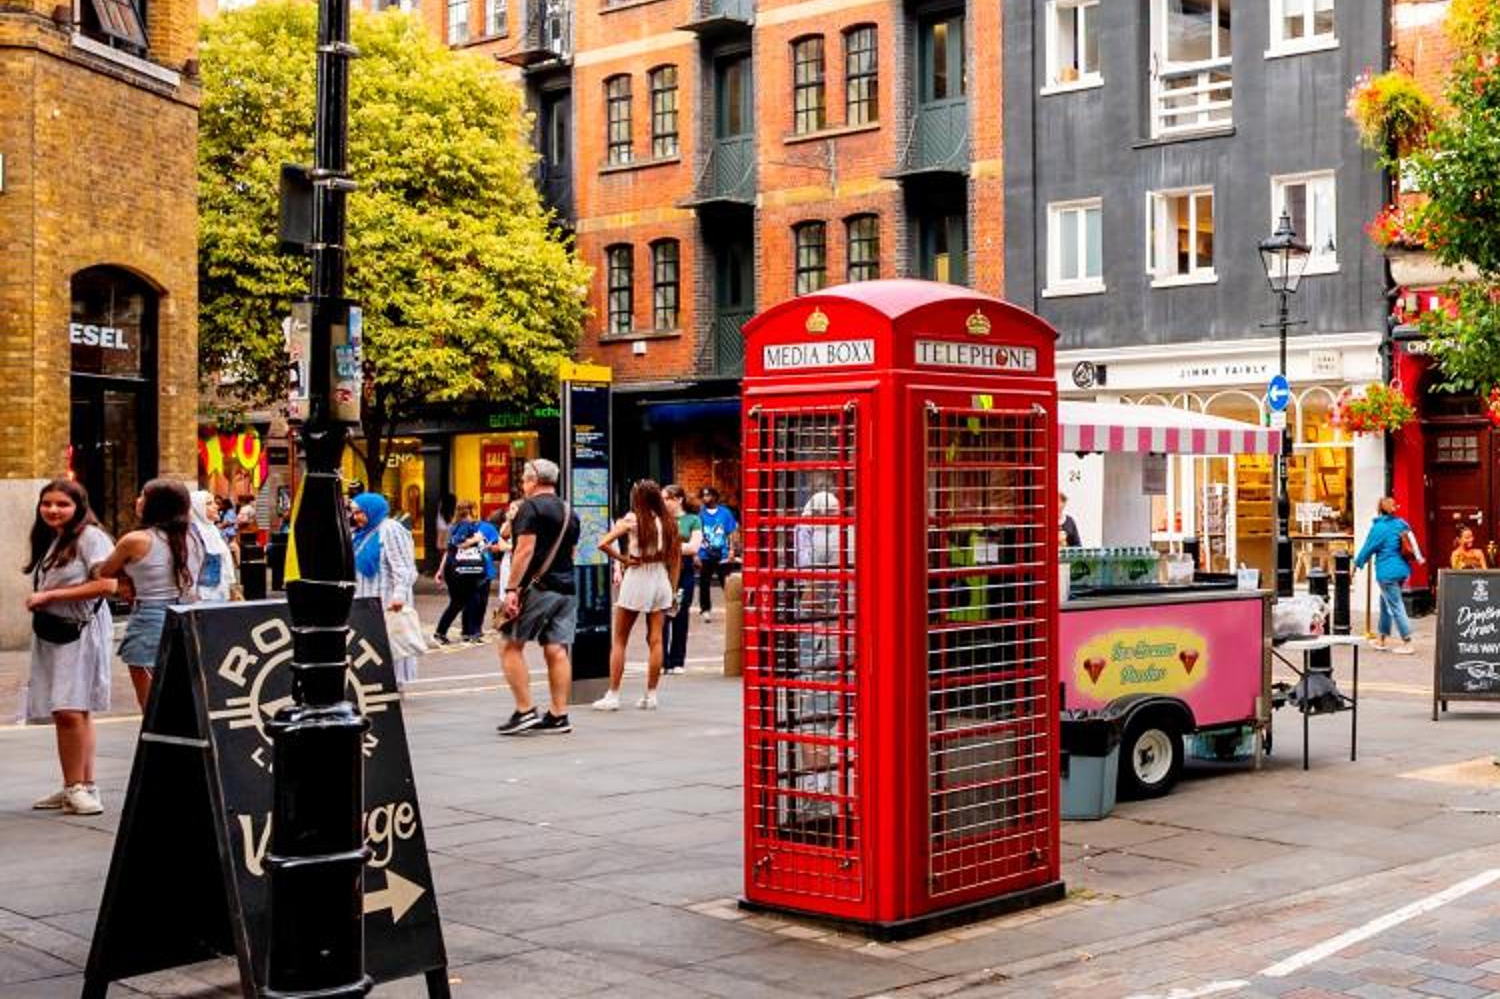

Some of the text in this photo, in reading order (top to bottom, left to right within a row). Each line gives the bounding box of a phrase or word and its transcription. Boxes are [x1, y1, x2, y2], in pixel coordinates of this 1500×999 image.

[767, 341, 873, 367] MEDIA BOXX
[919, 341, 1034, 369] TELEPHONE
